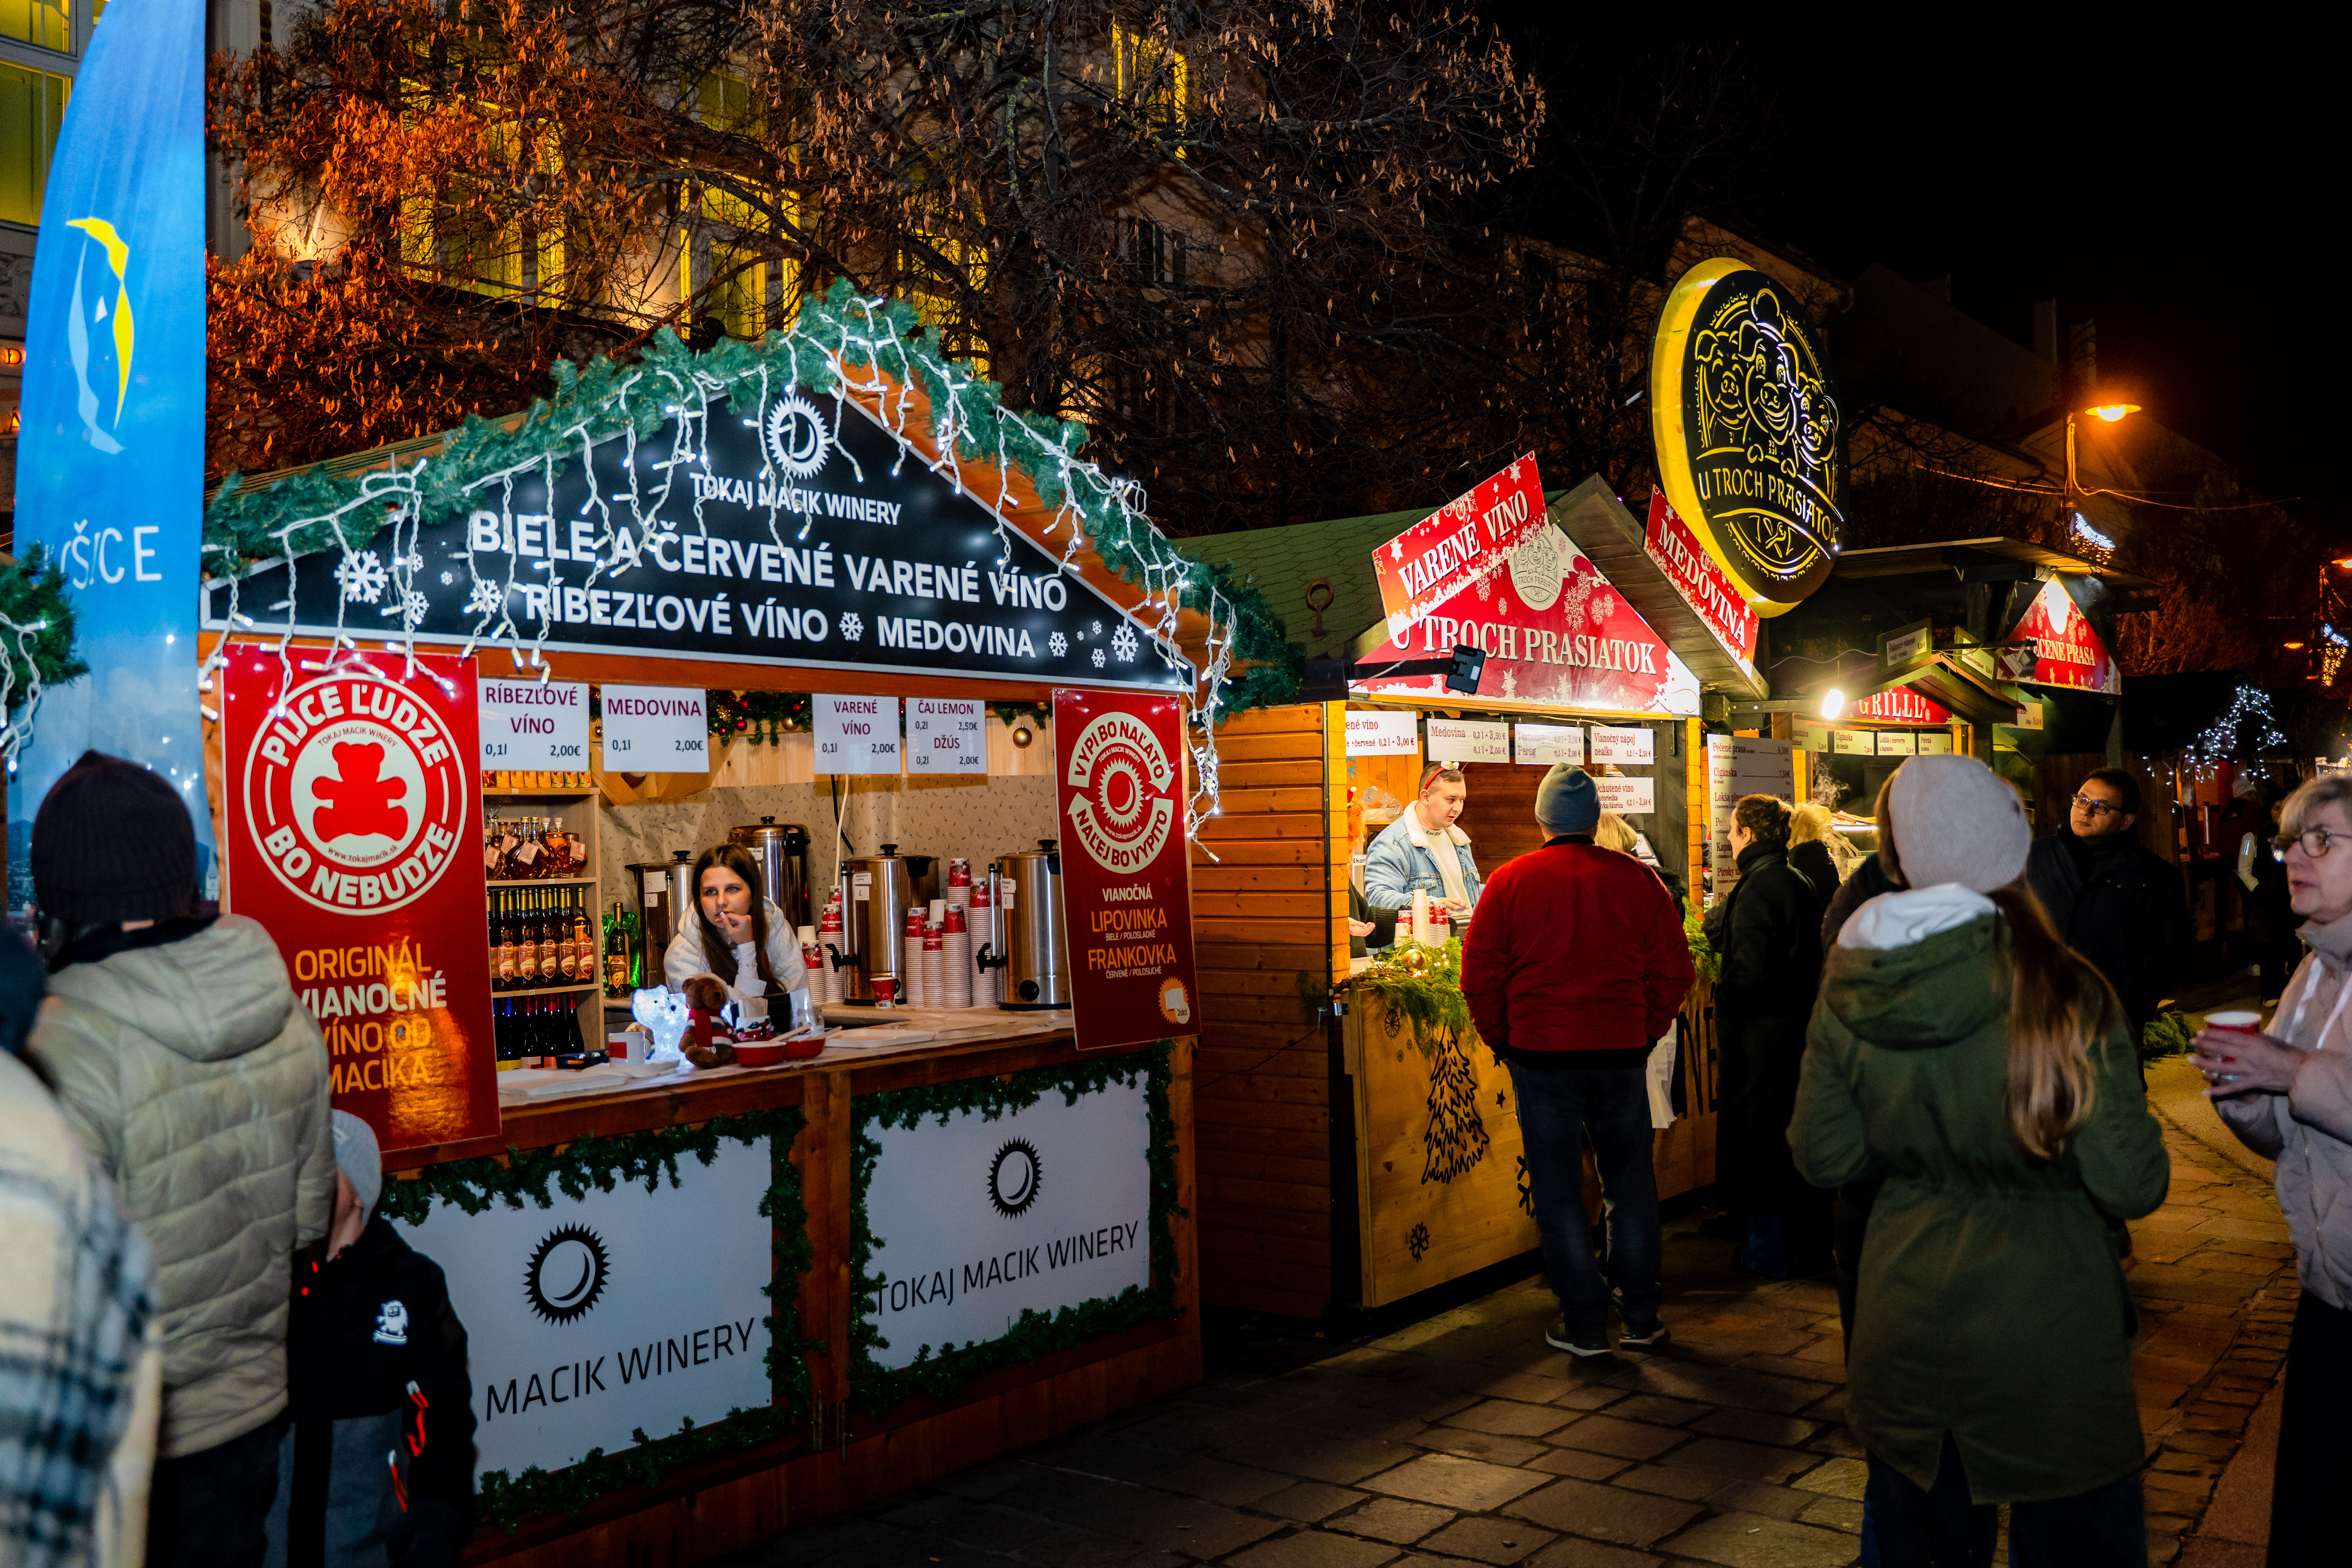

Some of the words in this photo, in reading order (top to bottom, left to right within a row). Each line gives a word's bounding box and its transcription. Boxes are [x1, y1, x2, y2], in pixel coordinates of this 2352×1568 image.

[690, 472, 754, 510] TOKAJ
[758, 485, 822, 515] MACIK
[824, 493, 901, 526] WINERY
[1699, 472, 1709, 501] U
[1713, 468, 1763, 498] TROCH
[1768, 474, 1835, 541] PRASIATO
[45, 519, 162, 589] ŠICE
[1397, 515, 1481, 600] VARENÉ
[1483, 490, 1529, 543] VÍNO
[472, 511, 596, 563] BIELE
[614, 526, 642, 567] A
[655, 520, 834, 588] ČERVENÉ
[843, 554, 980, 604] VARENÉ
[988, 566, 1067, 612] VÍNO
[1535, 576, 1559, 594] PRASIATOK
[1658, 518, 1746, 649] MEDOVINA
[526, 577, 732, 635] RÍBEZĽOVÉ
[741, 597, 828, 642] VÍNO
[877, 615, 1037, 659] MEDOVINA
[1419, 615, 1518, 662] TROCH
[1524, 627, 1657, 675] PRASIATOK
[2065, 643, 2096, 666] PRASA
[486, 683, 578, 706] RÍBEZĽOVÉ
[608, 698, 702, 717] MEDOVINA
[834, 699, 878, 714] VARENÉ
[918, 699, 935, 714] ČAJ
[938, 702, 974, 715] LEMON
[261, 685, 345, 767] PIJCE
[352, 684, 450, 768] ĽUDZE
[510, 713, 555, 734] VÍNO
[842, 720, 871, 735] VÍNO
[958, 722, 978, 731] 2,50€
[1346, 719, 1360, 730] ené
[1362, 719, 1378, 730] víno
[1431, 726, 1466, 738] Medovina
[318, 729, 342, 747] TOKAJ
[343, 726, 367, 735] MACIK
[369, 728, 397, 747] WINERY
[612, 739, 631, 751] 0,1l
[675, 740, 704, 752] 2,00€
[934, 735, 960, 749] DŽÚS
[1594, 733, 1619, 745] Vianočný
[1621, 733, 1635, 745] nápoj
[1836, 732, 1853, 742] Cigánska
[485, 744, 507, 757] 0,1l
[550, 745, 581, 757] 2,00€
[822, 743, 837, 754] 0,1l
[872, 744, 895, 755] 2,00€
[1075, 731, 1100, 777] VYPI
[1097, 721, 1117, 742] BO
[1120, 720, 1165, 779] NAĽATO
[1098, 747, 1111, 763] TOKAJ
[1125, 747, 1141, 763] WINERY
[1595, 746, 1613, 756] nealko
[1713, 742, 1731, 752] Pečené
[1732, 746, 1746, 755] prasa
[959, 756, 979, 766] 2,00€
[1714, 767, 1737, 779] Cigánska
[1622, 784, 1634, 793] víno
[1715, 792, 1730, 801] Lokša
[1111, 850, 1129, 867] BO
[1130, 809, 1167, 865] VYPITO
[328, 844, 399, 863] www.tokajmacik.sk
[265, 824, 312, 879] BO
[310, 822, 454, 906] NEBUDZE
[1102, 883, 1153, 902] VIANOČNÁ
[1091, 907, 1167, 932] LIPOVINKA
[1105, 933, 1119, 941] BIELE
[1123, 929, 1156, 940] POLOSLADKÉ
[295, 936, 432, 981] ORIGINÁL
[1088, 943, 1176, 971] FRANKOVKA
[1106, 966, 1128, 979] ČERVENÉ
[1132, 965, 1162, 976] POLOSUCHÉ
[391, 1018, 432, 1049] OD
[878, 1268, 954, 1316] TOKAJ
[964, 1245, 1040, 1294] MACIK
[1047, 1220, 1138, 1269] WINERY
[486, 1356, 606, 1421] MACIK
[617, 1317, 755, 1385] WINERY
